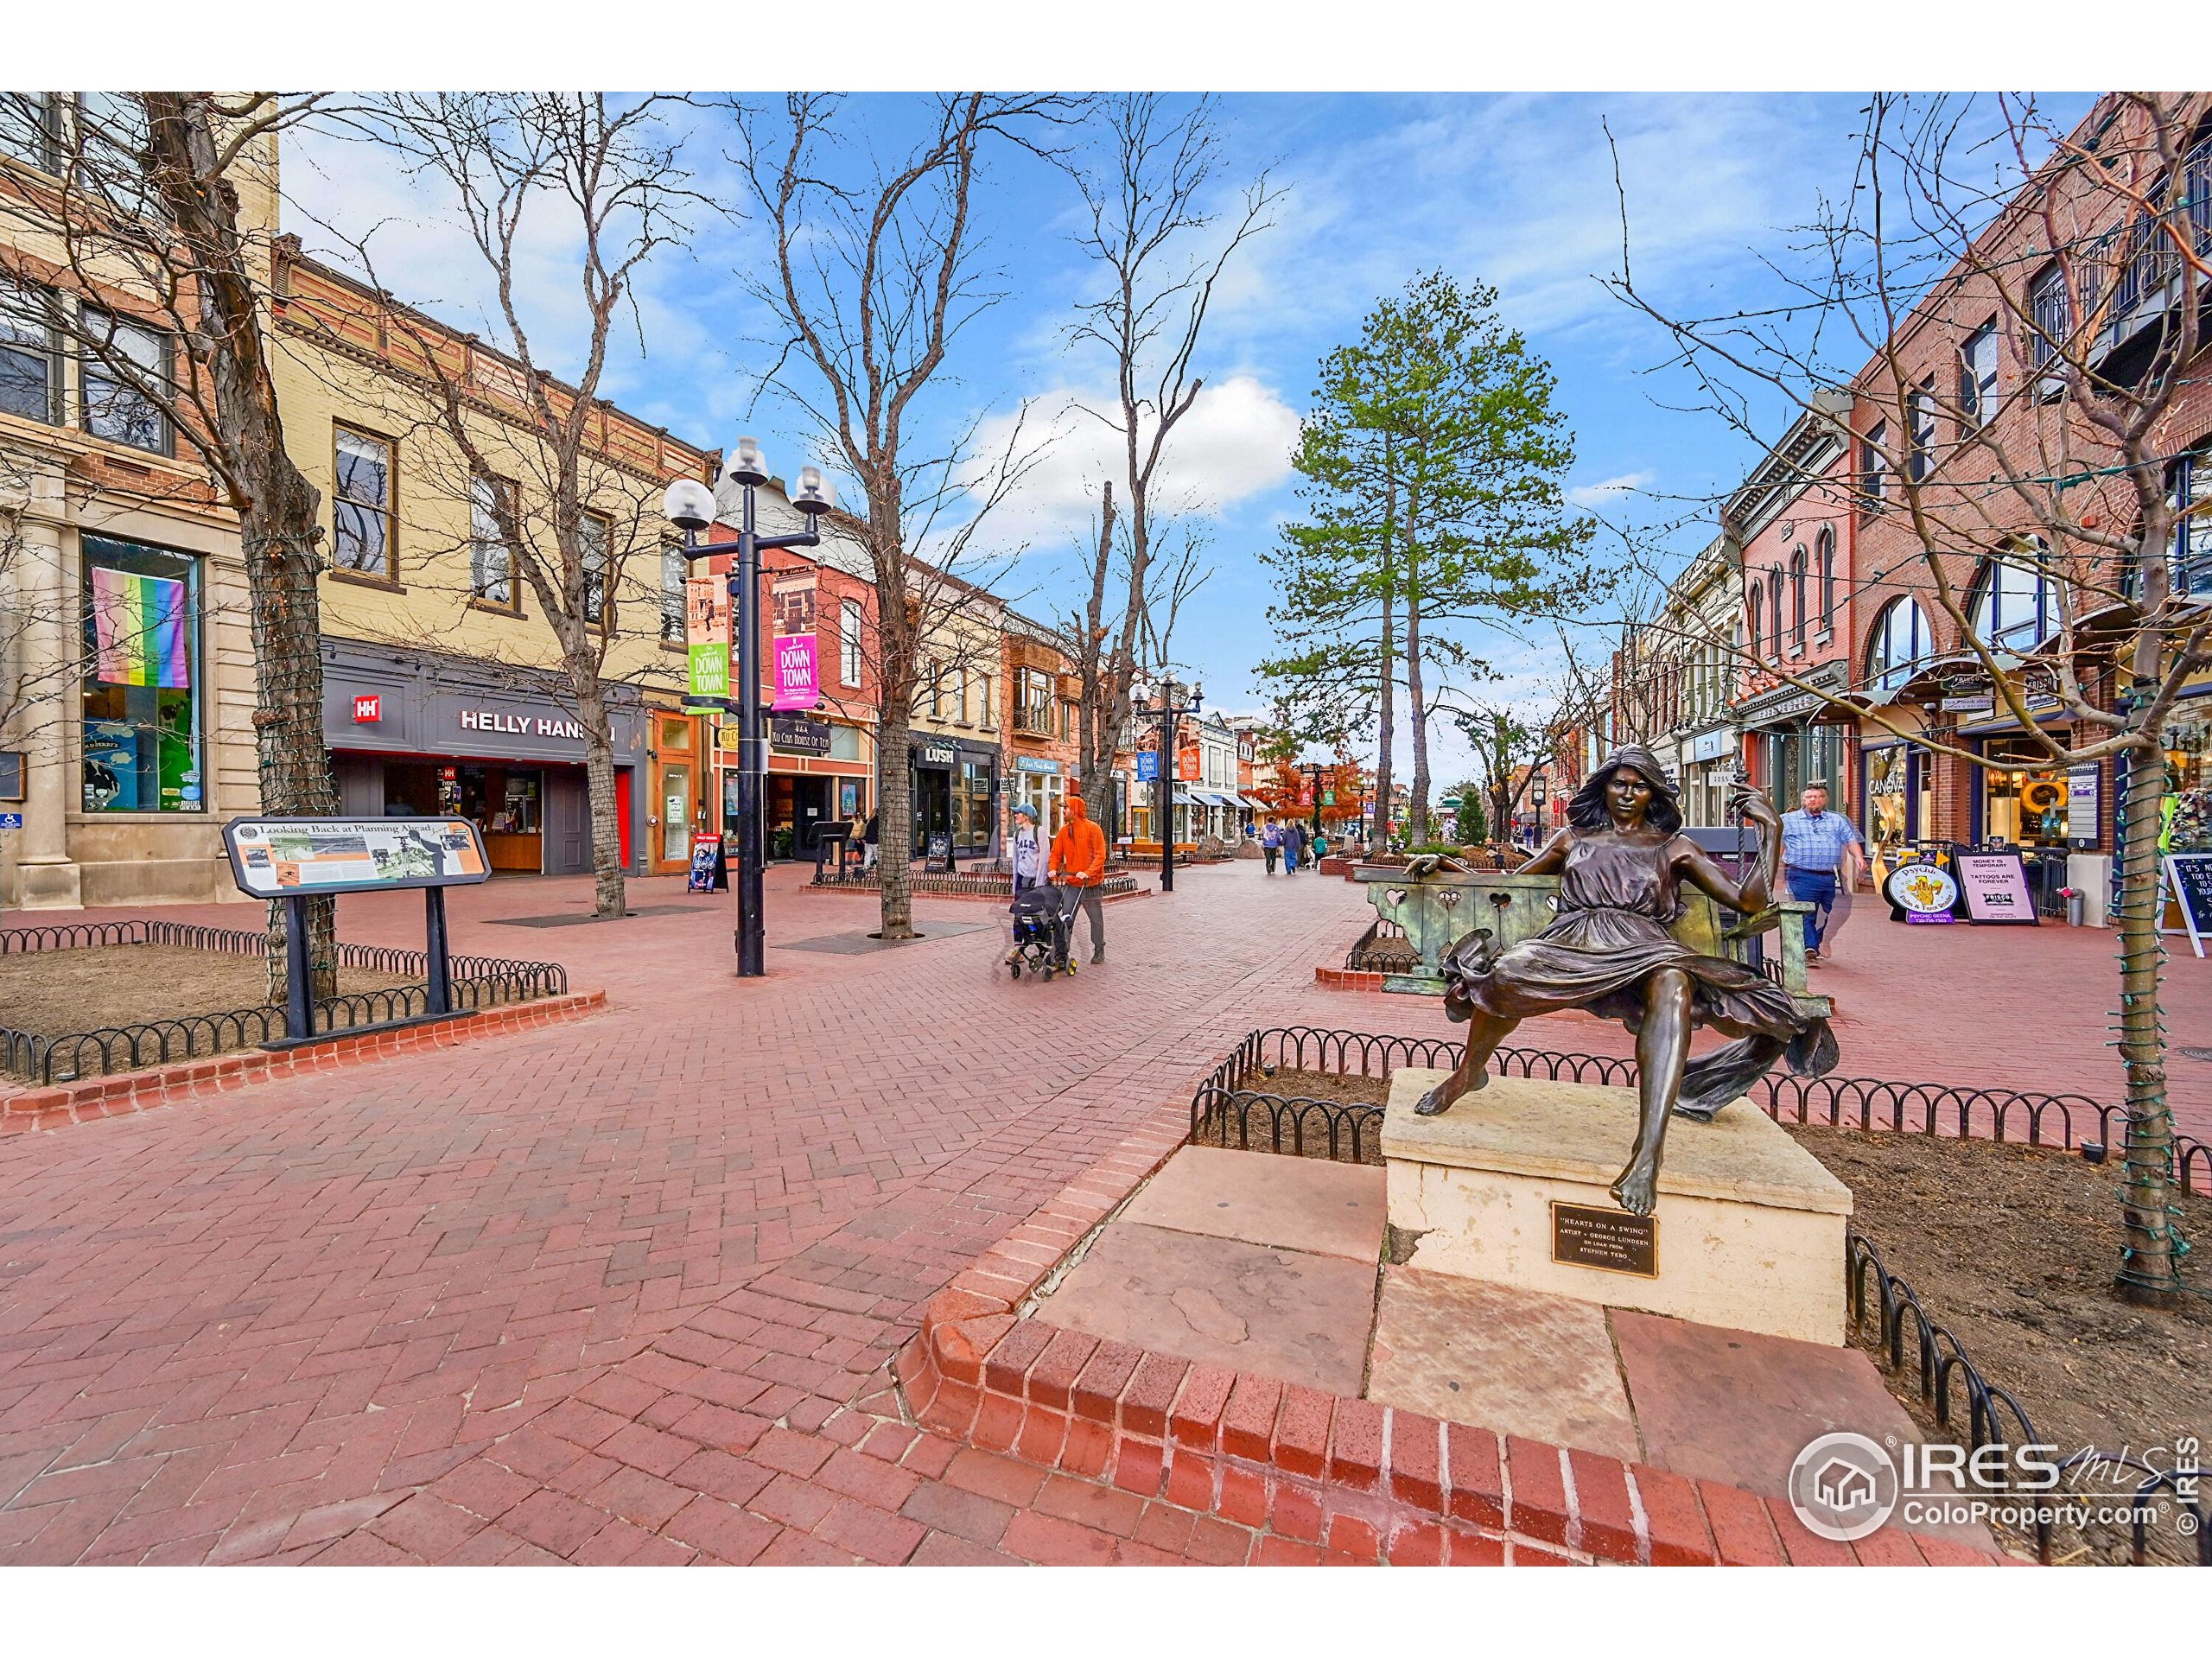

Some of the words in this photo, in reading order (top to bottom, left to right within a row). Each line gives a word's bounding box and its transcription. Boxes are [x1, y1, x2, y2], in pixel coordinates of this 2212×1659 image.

[695, 657, 723, 675] DOWN
[780, 649, 810, 669] DOWN
[696, 673, 723, 692] TOWN
[781, 668, 812, 687] TOWN
[461, 710, 531, 734] HELLY
[537, 719, 615, 741] HANS
[925, 747, 954, 764] LUSH
[1868, 779, 1904, 794] CANOVA
[259, 825, 308, 835] Looking
[311, 824, 340, 833] Back
[353, 824, 399, 834] Planning
[1560, 1228, 1582, 1236] ARTIST
[1589, 1232, 1616, 1242] GEORGE
[1580, 1247, 1608, 1256] STEPHEN
